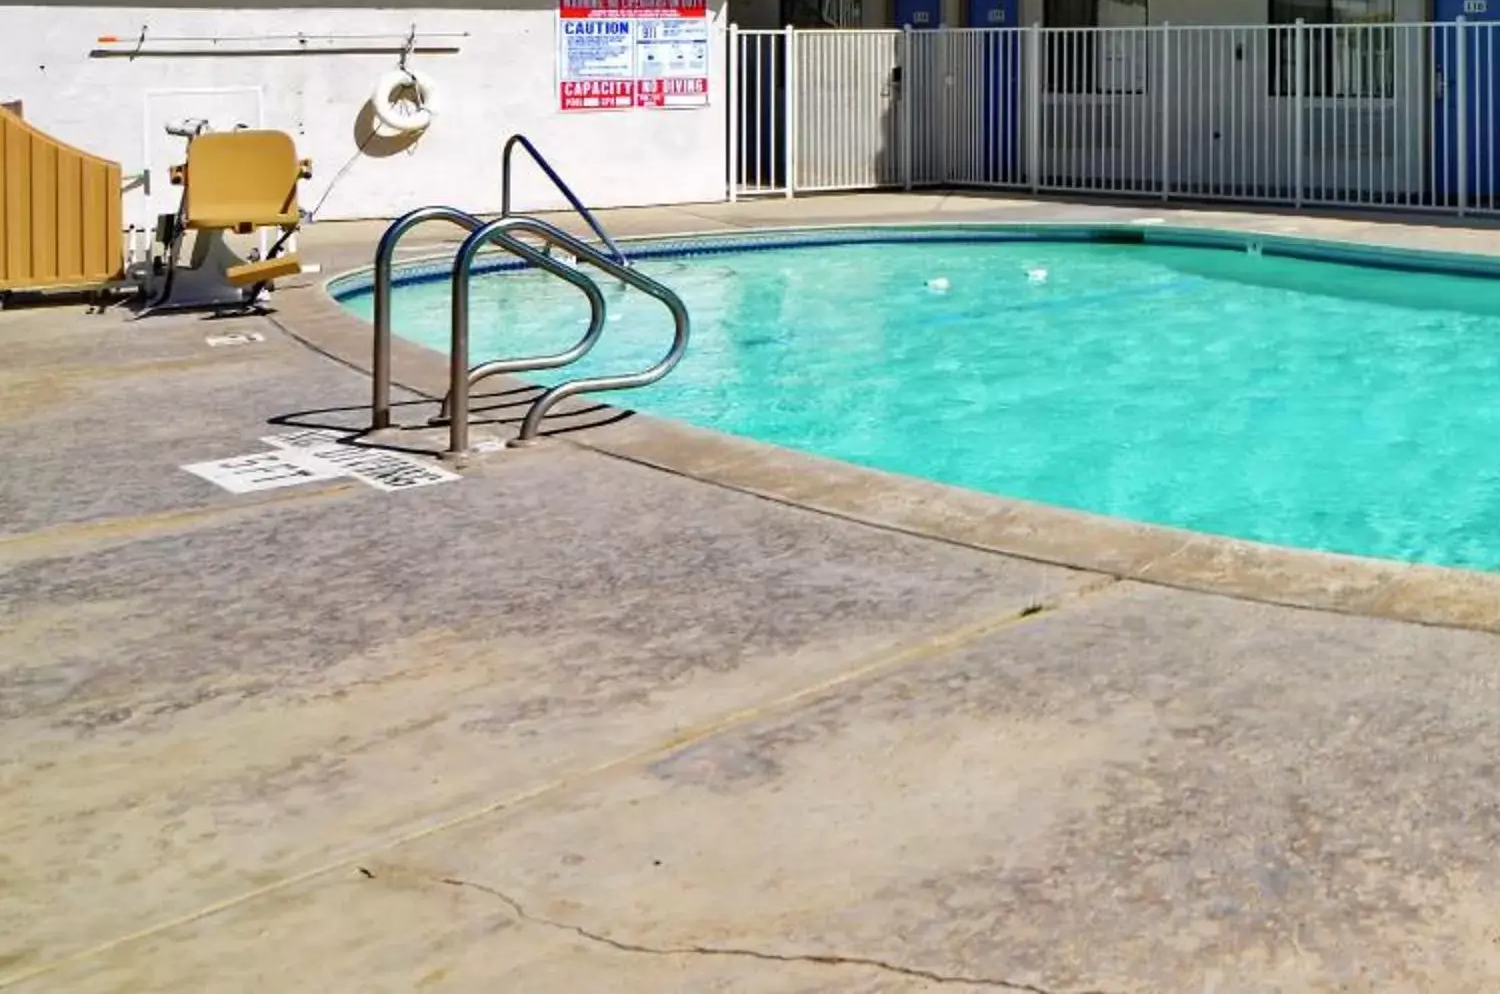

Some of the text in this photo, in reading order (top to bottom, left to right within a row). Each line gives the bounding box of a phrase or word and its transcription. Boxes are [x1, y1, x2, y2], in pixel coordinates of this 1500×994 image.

[565, 21, 630, 35] CAUTION
[564, 81, 632, 97] CAPACITY
[663, 79, 704, 94] DIVING
